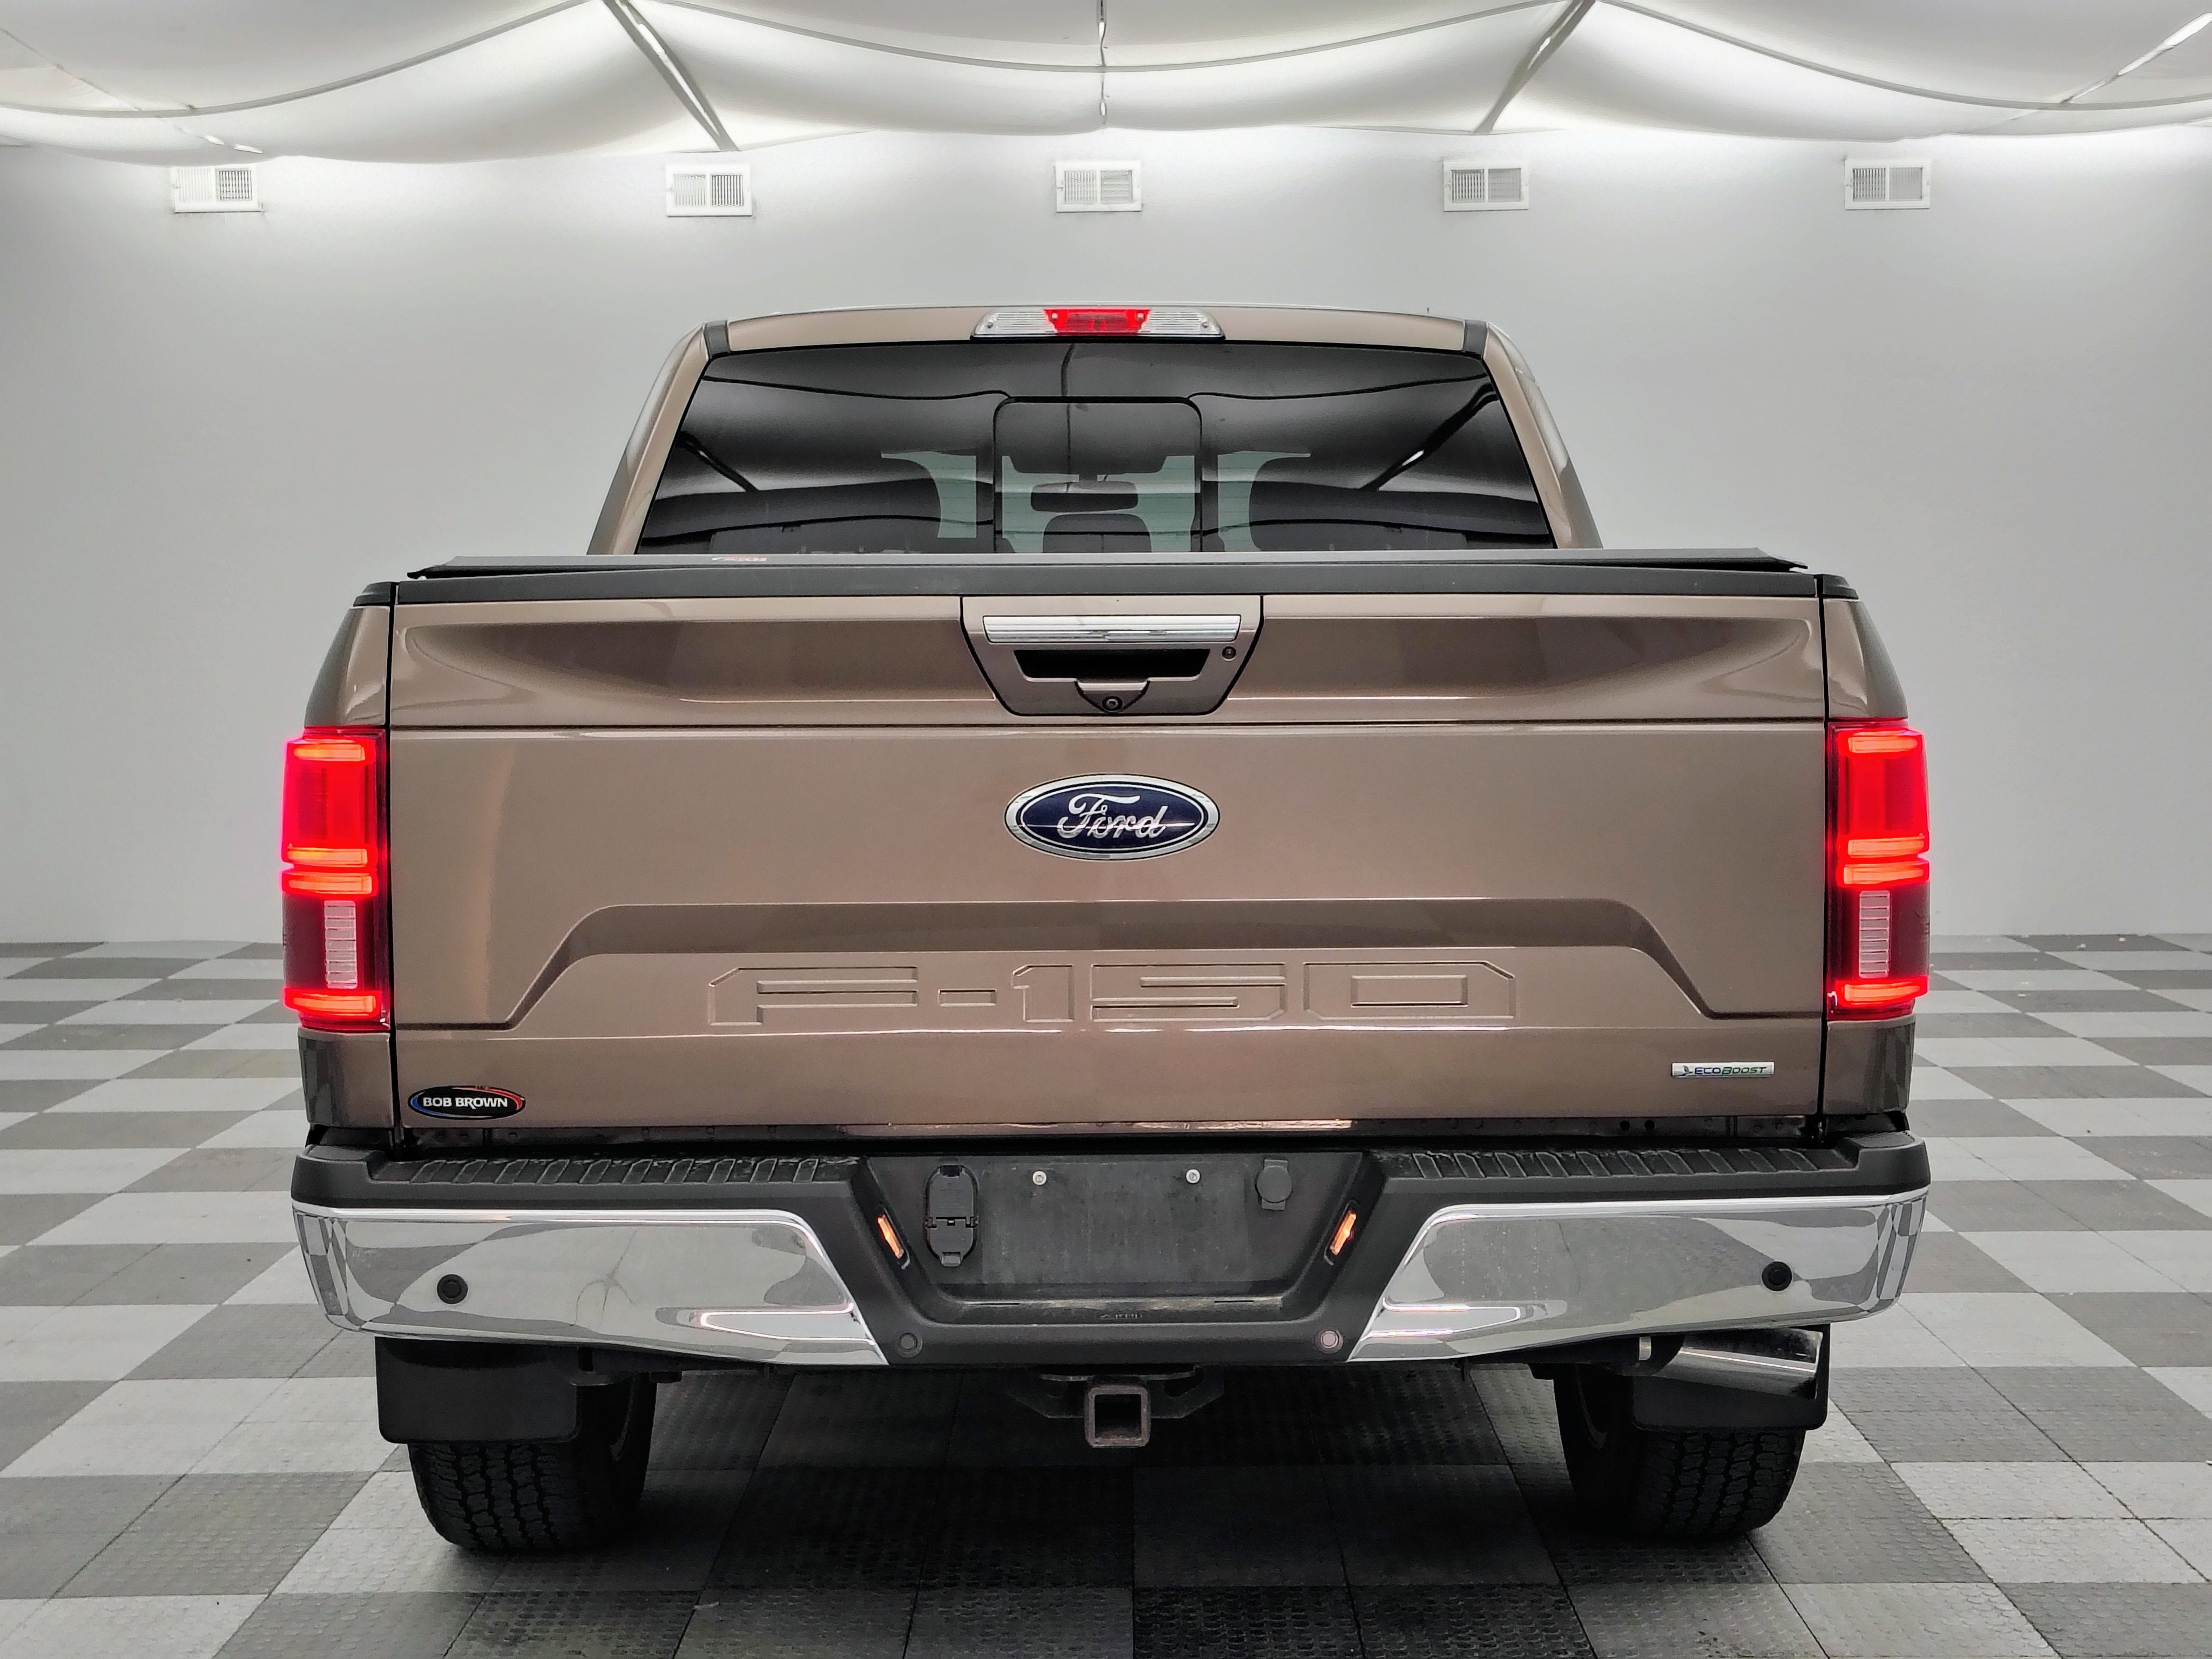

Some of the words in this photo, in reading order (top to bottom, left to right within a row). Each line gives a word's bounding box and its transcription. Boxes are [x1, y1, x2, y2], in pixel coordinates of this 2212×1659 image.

[1057, 793, 1169, 839] Ford
[707, 961, 1516, 1026] F-150
[1695, 1067, 1767, 1075] ECOBOOST
[423, 1097, 453, 1107] BOB
[455, 1097, 508, 1110] BROWN
